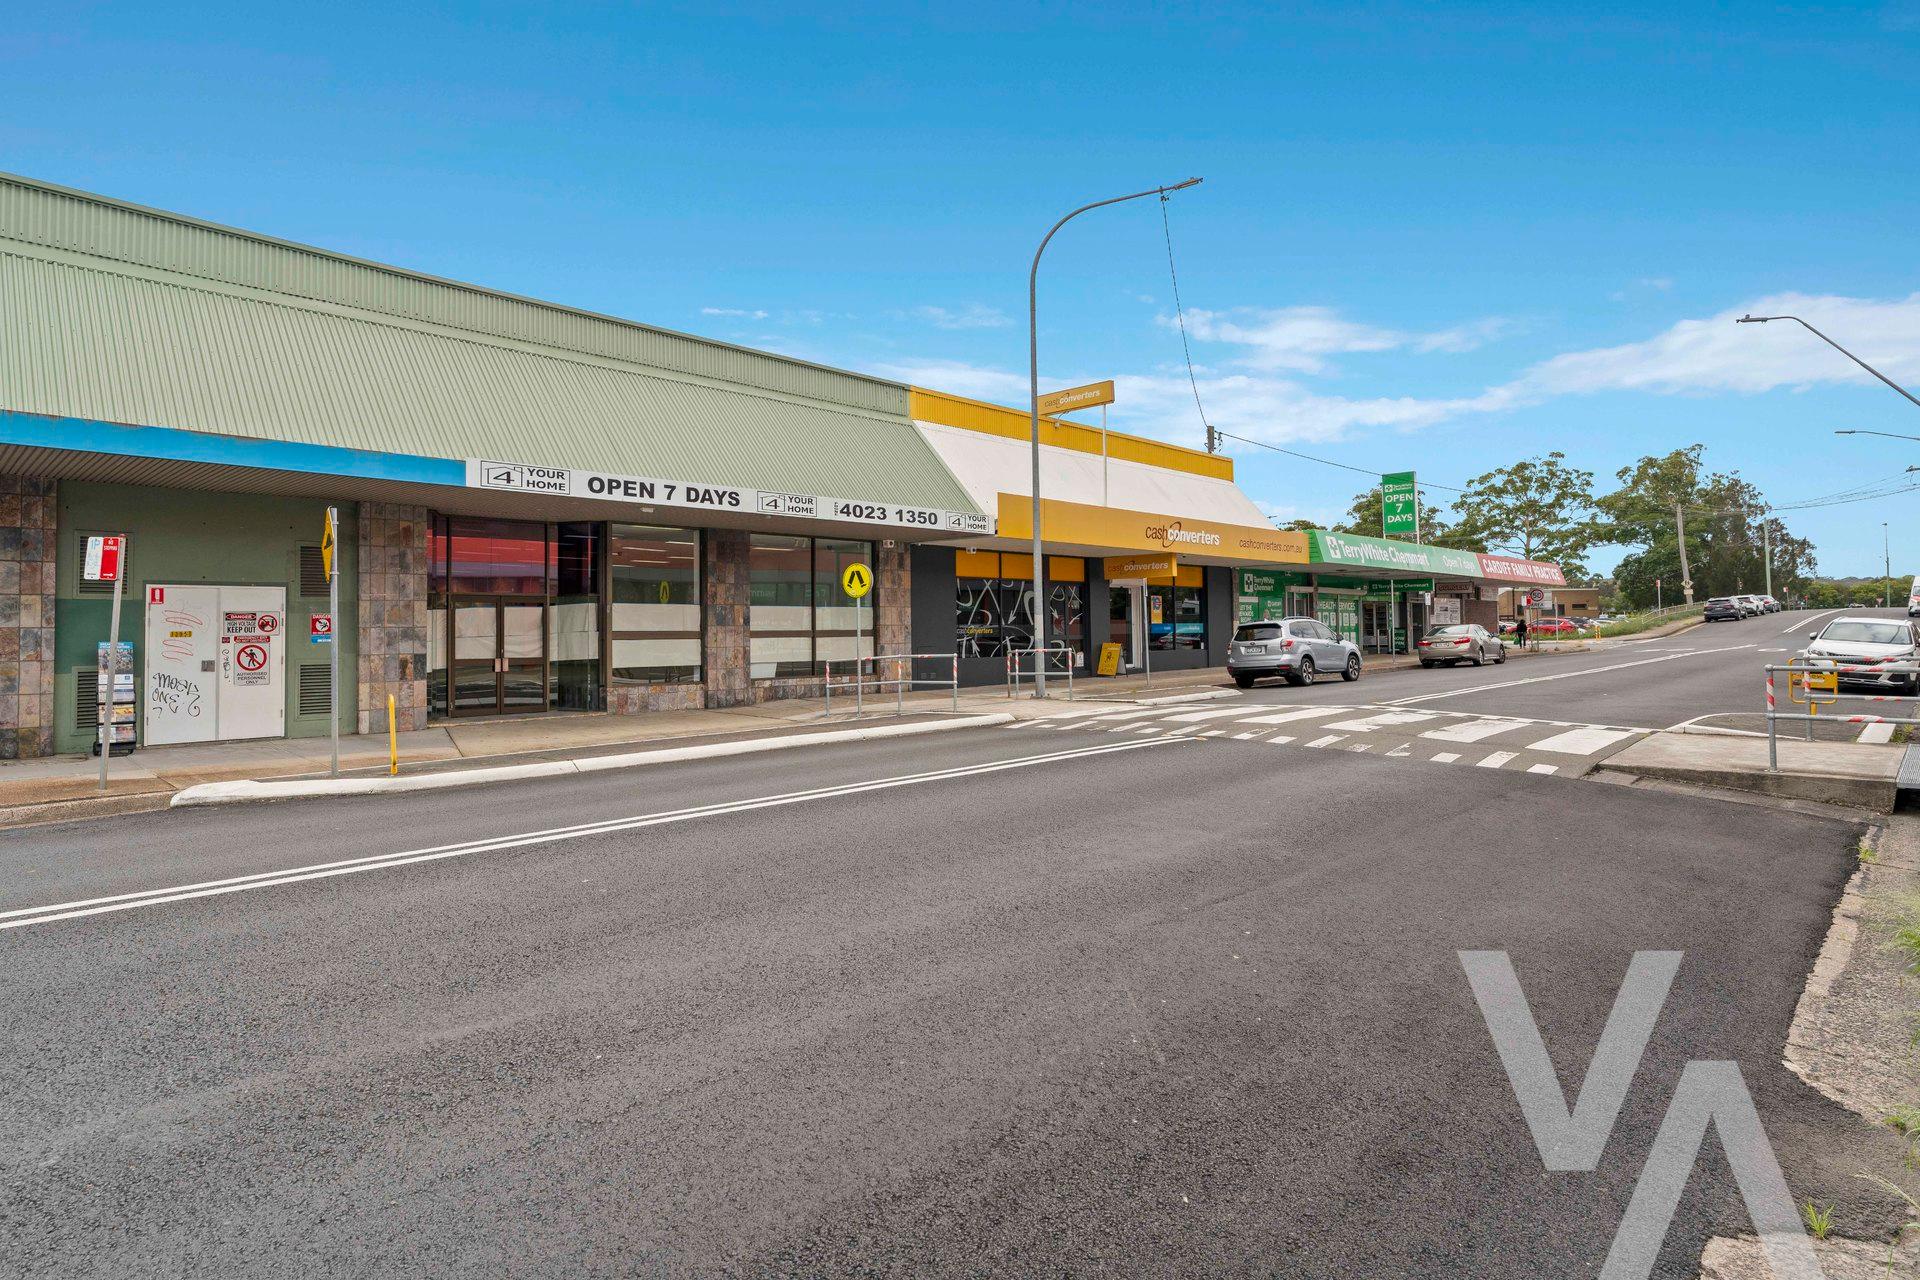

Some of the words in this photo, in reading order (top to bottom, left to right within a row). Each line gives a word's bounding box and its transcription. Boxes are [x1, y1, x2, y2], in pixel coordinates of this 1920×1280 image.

[493, 470, 516, 485] 4
[526, 467, 566, 480] YOUR
[526, 479, 566, 492] HOME
[587, 476, 656, 499] OPEN
[663, 484, 677, 501] 7
[685, 486, 741, 507] DAYS
[764, 497, 782, 510] 4
[787, 495, 814, 506] YOUR
[1385, 493, 1413, 502] OPEN
[787, 505, 815, 515] HOME
[839, 502, 888, 521] 4023
[895, 508, 939, 526] 1350
[1395, 503, 1403, 513] 7
[967, 514, 987, 523] YOUR
[1387, 513, 1413, 523] DAYS
[966, 522, 988, 531] HOME
[1239, 539, 1303, 554] cashconverters.com.au
[1338, 540, 1390, 564] TerryWhite
[1482, 558, 1512, 575] CARDIFF
[1511, 562, 1534, 578] FAMILY
[1533, 565, 1561, 580] PRACTICE
